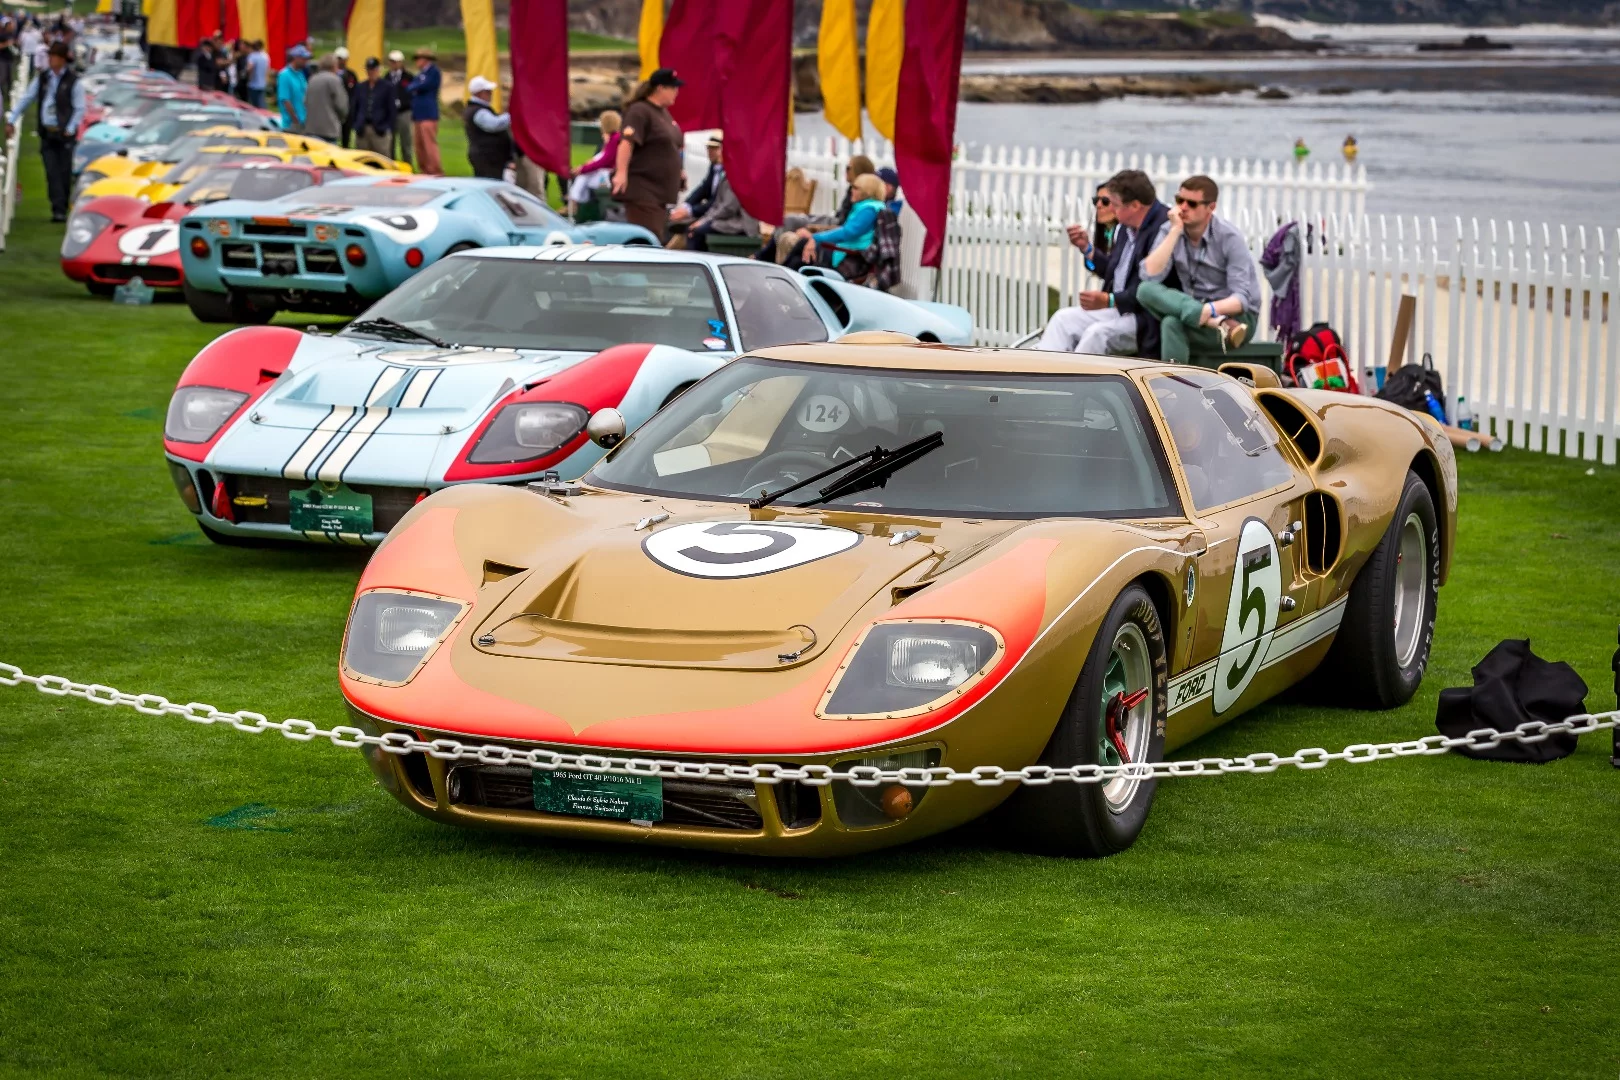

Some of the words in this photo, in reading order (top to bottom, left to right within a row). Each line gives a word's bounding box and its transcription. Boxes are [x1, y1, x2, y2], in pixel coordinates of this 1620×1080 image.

[138, 229, 171, 250] 1
[805, 403, 839, 423] 124
[676, 521, 808, 565] 5
[1226, 543, 1272, 691] 5
[1174, 673, 1207, 705] FORD
[582, 773, 594, 781] GT
